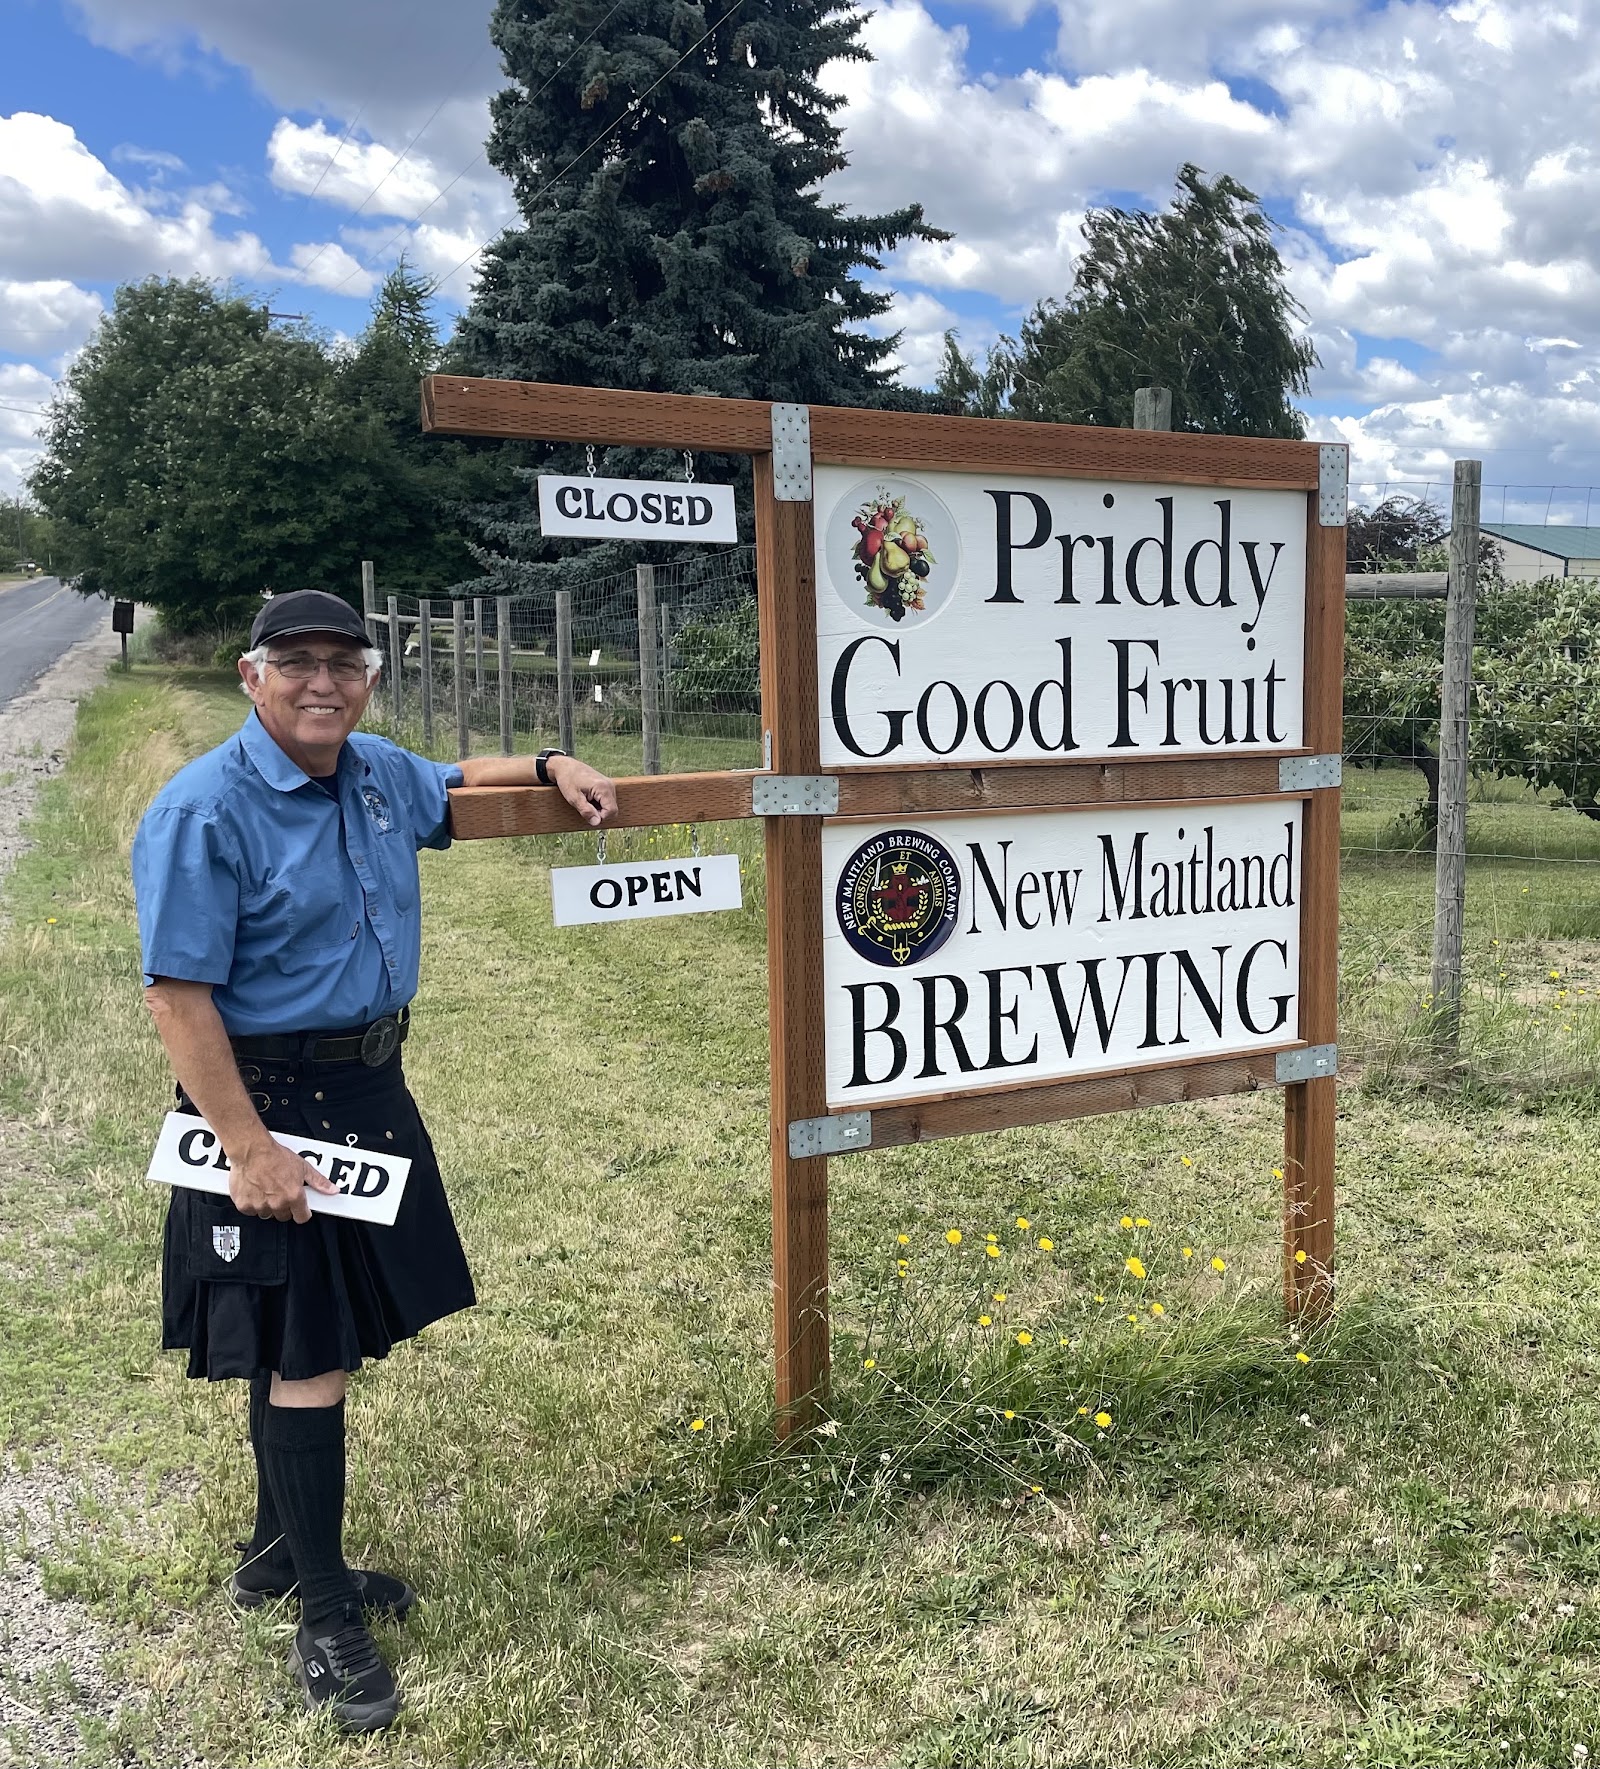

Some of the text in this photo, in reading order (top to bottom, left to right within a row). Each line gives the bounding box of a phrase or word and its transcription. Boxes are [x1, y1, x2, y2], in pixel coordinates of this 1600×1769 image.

[555, 486, 713, 526] CLOSED
[984, 489, 1285, 633] Priddy
[831, 636, 1288, 758] Good Fruit
[589, 867, 702, 909] OPEN
[841, 835, 957, 930] NEW MAITLAND BREWING COMPANY
[856, 851, 943, 916] CONSILIO ET ANIMIS
[966, 821, 1296, 934] New Maitland
[841, 939, 1296, 1089] BREWING
[178, 1129, 390, 1198] CED
